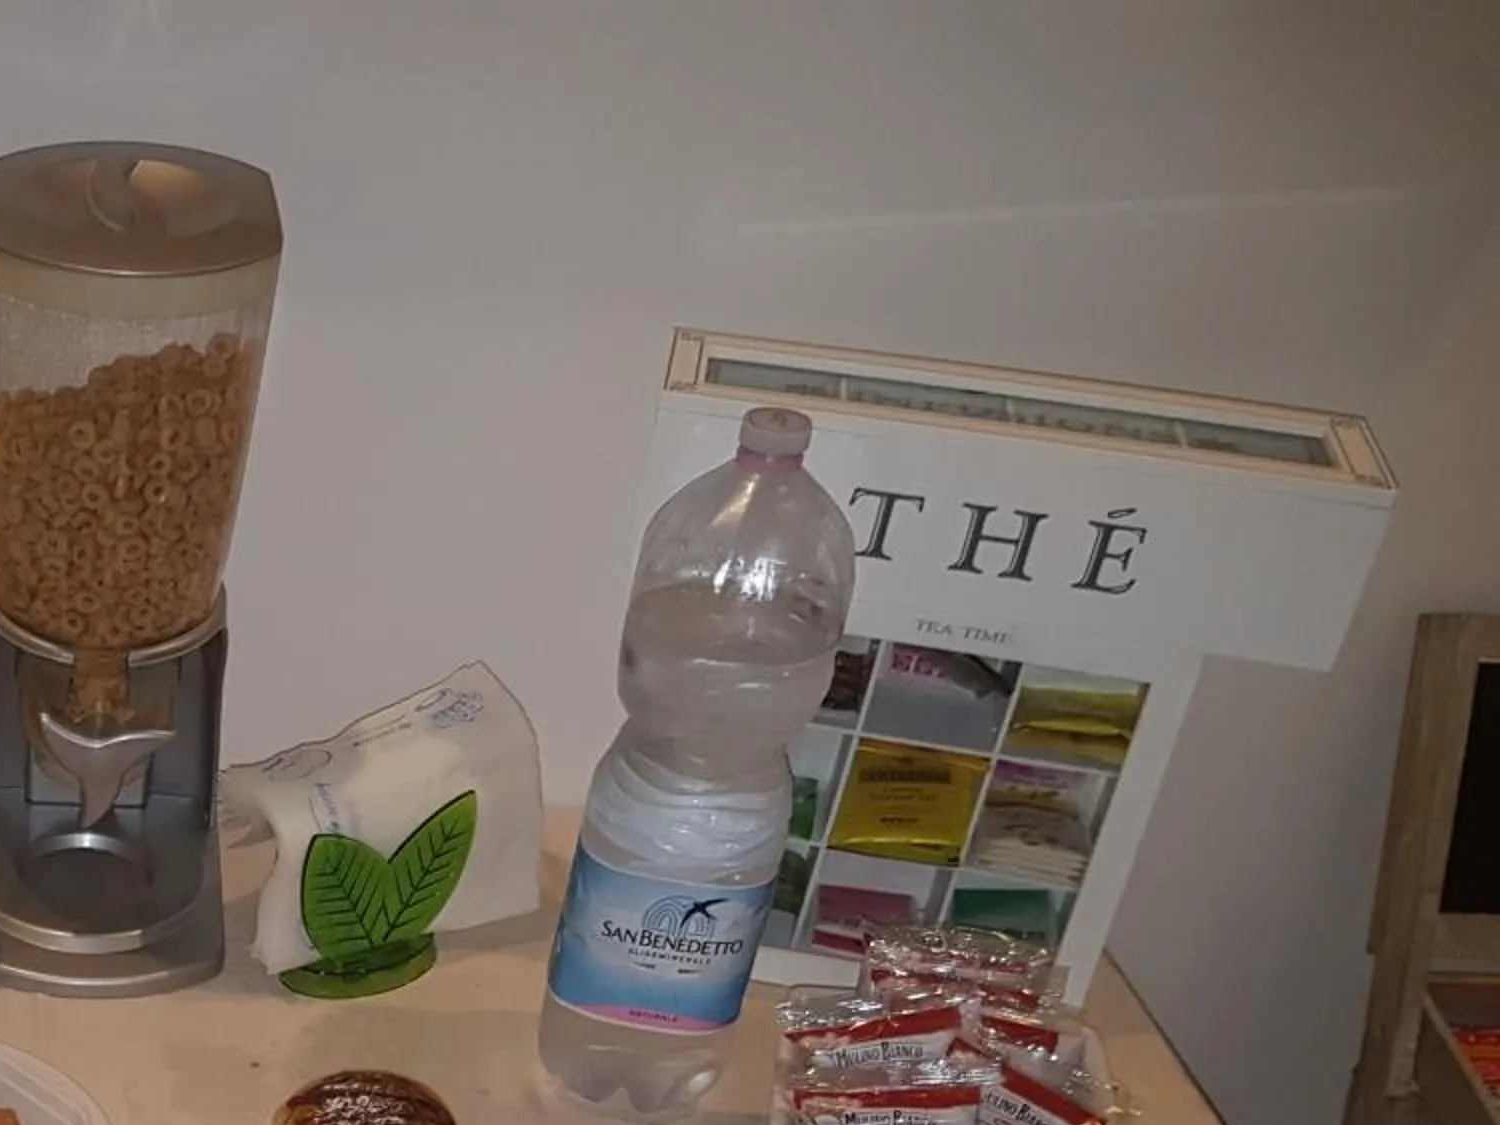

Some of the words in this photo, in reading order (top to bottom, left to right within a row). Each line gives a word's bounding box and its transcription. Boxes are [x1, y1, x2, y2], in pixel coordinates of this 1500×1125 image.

[849, 488, 1148, 595] THÉ
[915, 618, 954, 637] TEA
[957, 625, 1014, 644] TIME
